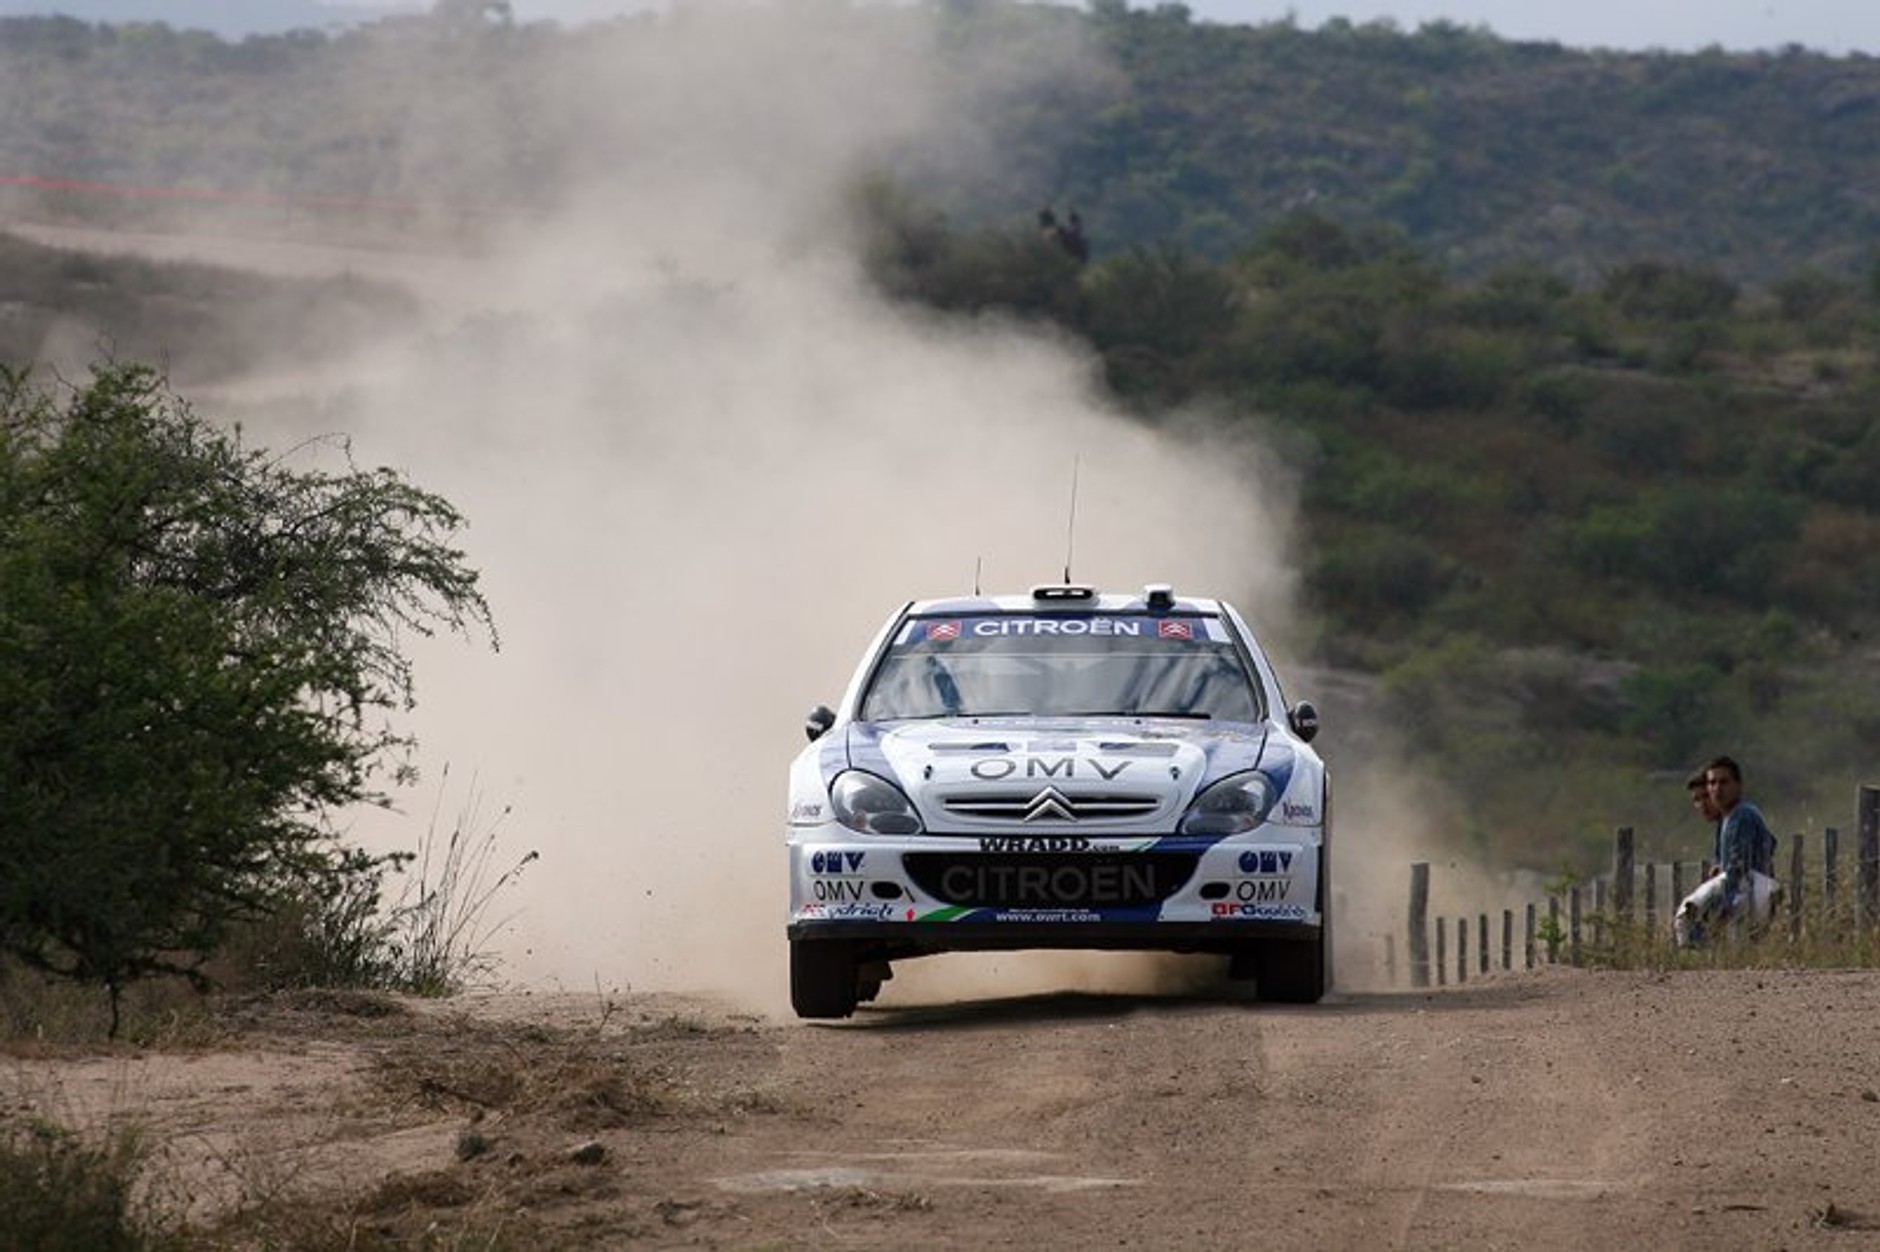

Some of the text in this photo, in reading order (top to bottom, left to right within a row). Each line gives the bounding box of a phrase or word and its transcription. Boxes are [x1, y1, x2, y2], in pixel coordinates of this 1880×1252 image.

[975, 619, 1139, 636] CITROËN
[971, 757, 1134, 780] OMV
[813, 880, 865, 901] OMV
[1237, 880, 1291, 902] OMV
